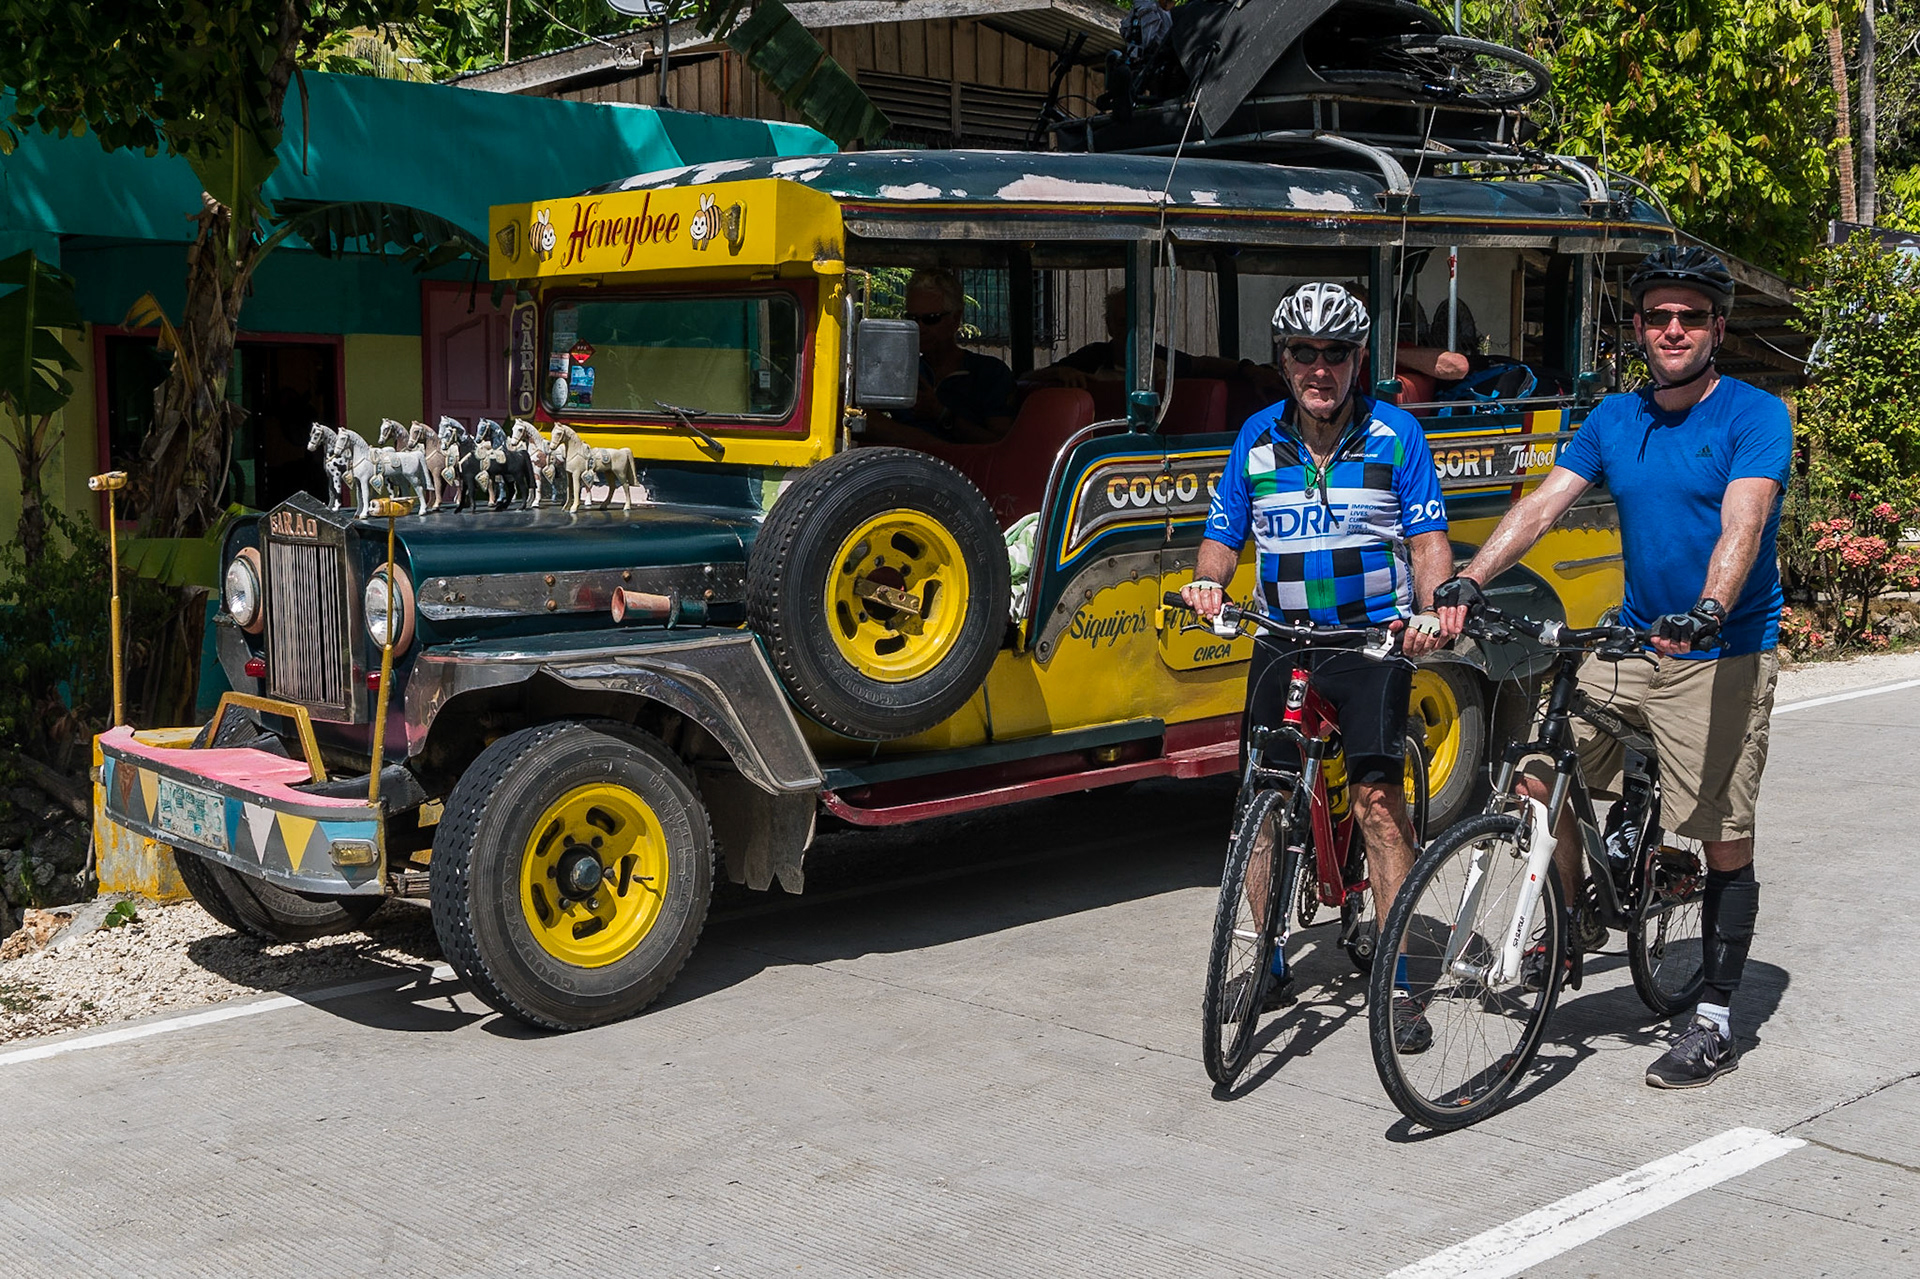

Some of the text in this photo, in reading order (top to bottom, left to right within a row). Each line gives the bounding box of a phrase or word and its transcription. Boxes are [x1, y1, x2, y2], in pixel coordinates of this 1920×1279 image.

[559, 192, 680, 269] Honeybee
[519, 310, 534, 412] SARAO
[1433, 447, 1499, 479] SORT,
[1508, 442, 1558, 474] Tubod
[1106, 473, 1199, 509] COCO
[1262, 503, 1349, 539] JDRF
[1070, 605, 1148, 648] Siquijor's
[1193, 643, 1232, 662] CIRCA
